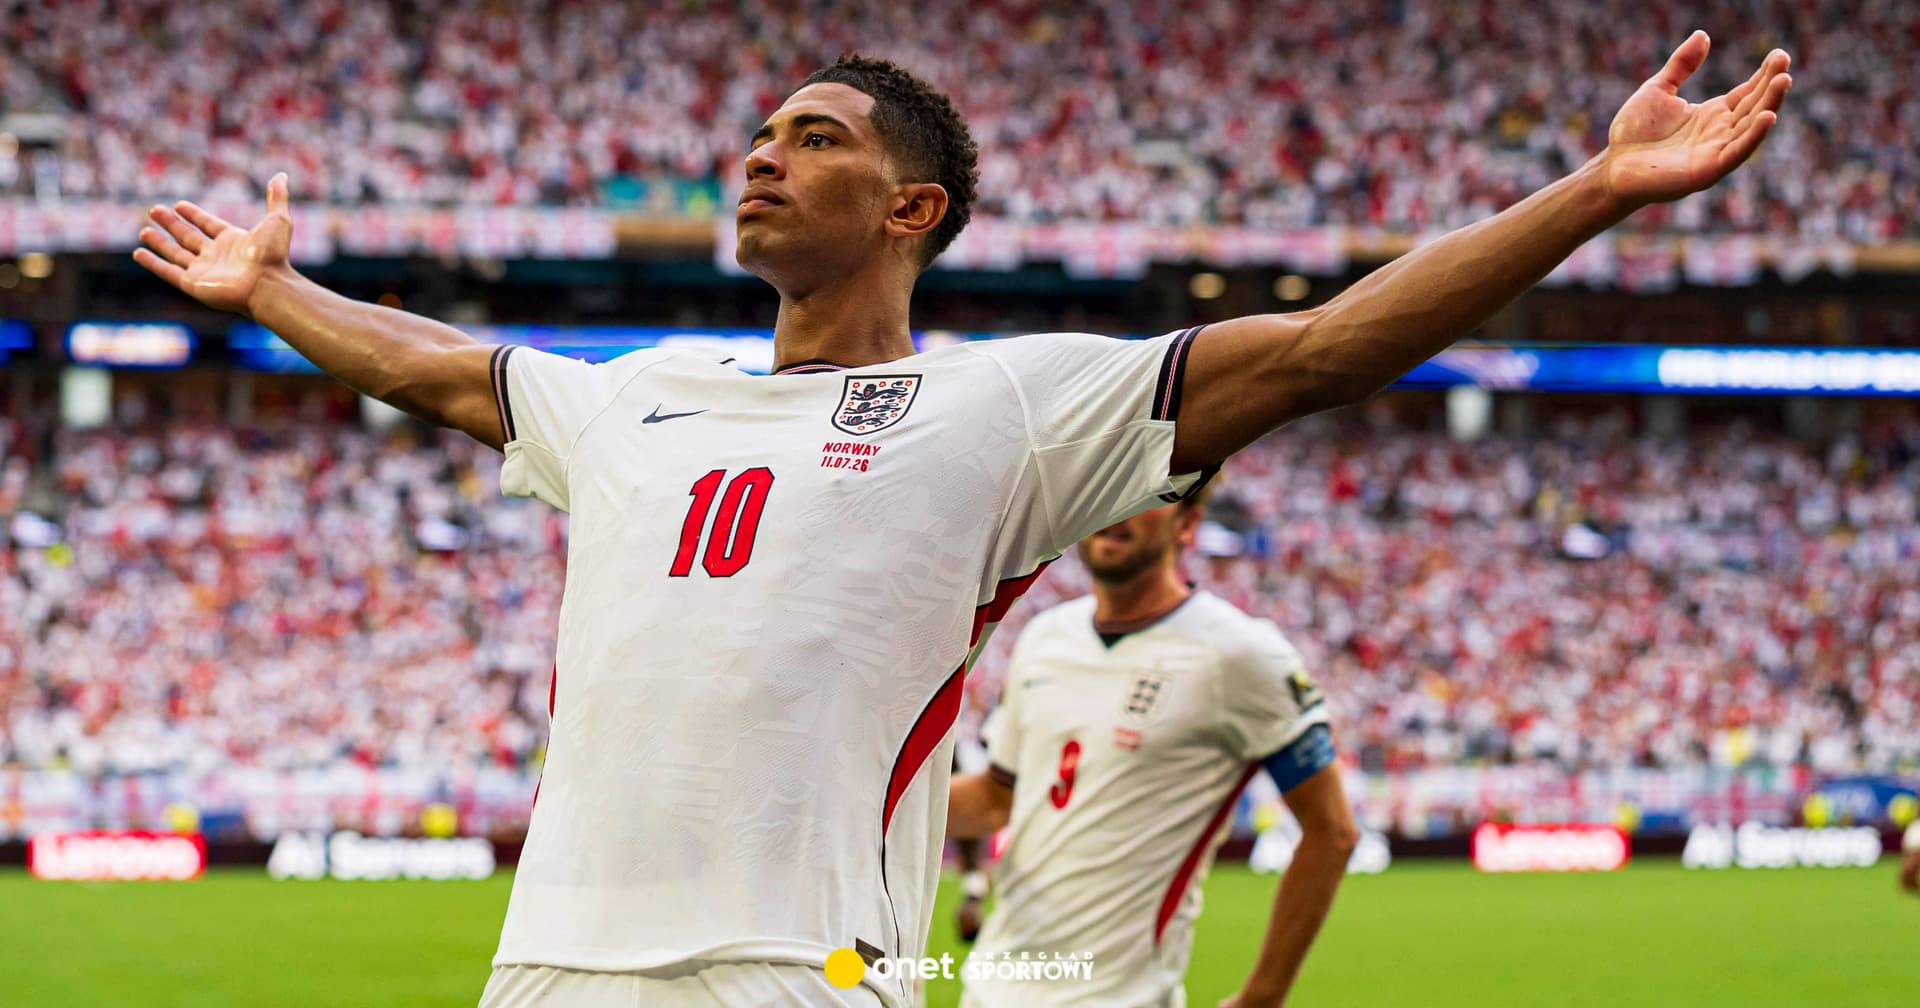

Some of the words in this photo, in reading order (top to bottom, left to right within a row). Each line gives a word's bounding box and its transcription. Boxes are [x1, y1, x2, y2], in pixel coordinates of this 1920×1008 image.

[820, 456, 869, 472] 11.07.26
[822, 442, 882, 456] NORWAY
[668, 466, 775, 578] 10
[1049, 738, 1082, 811] 9
